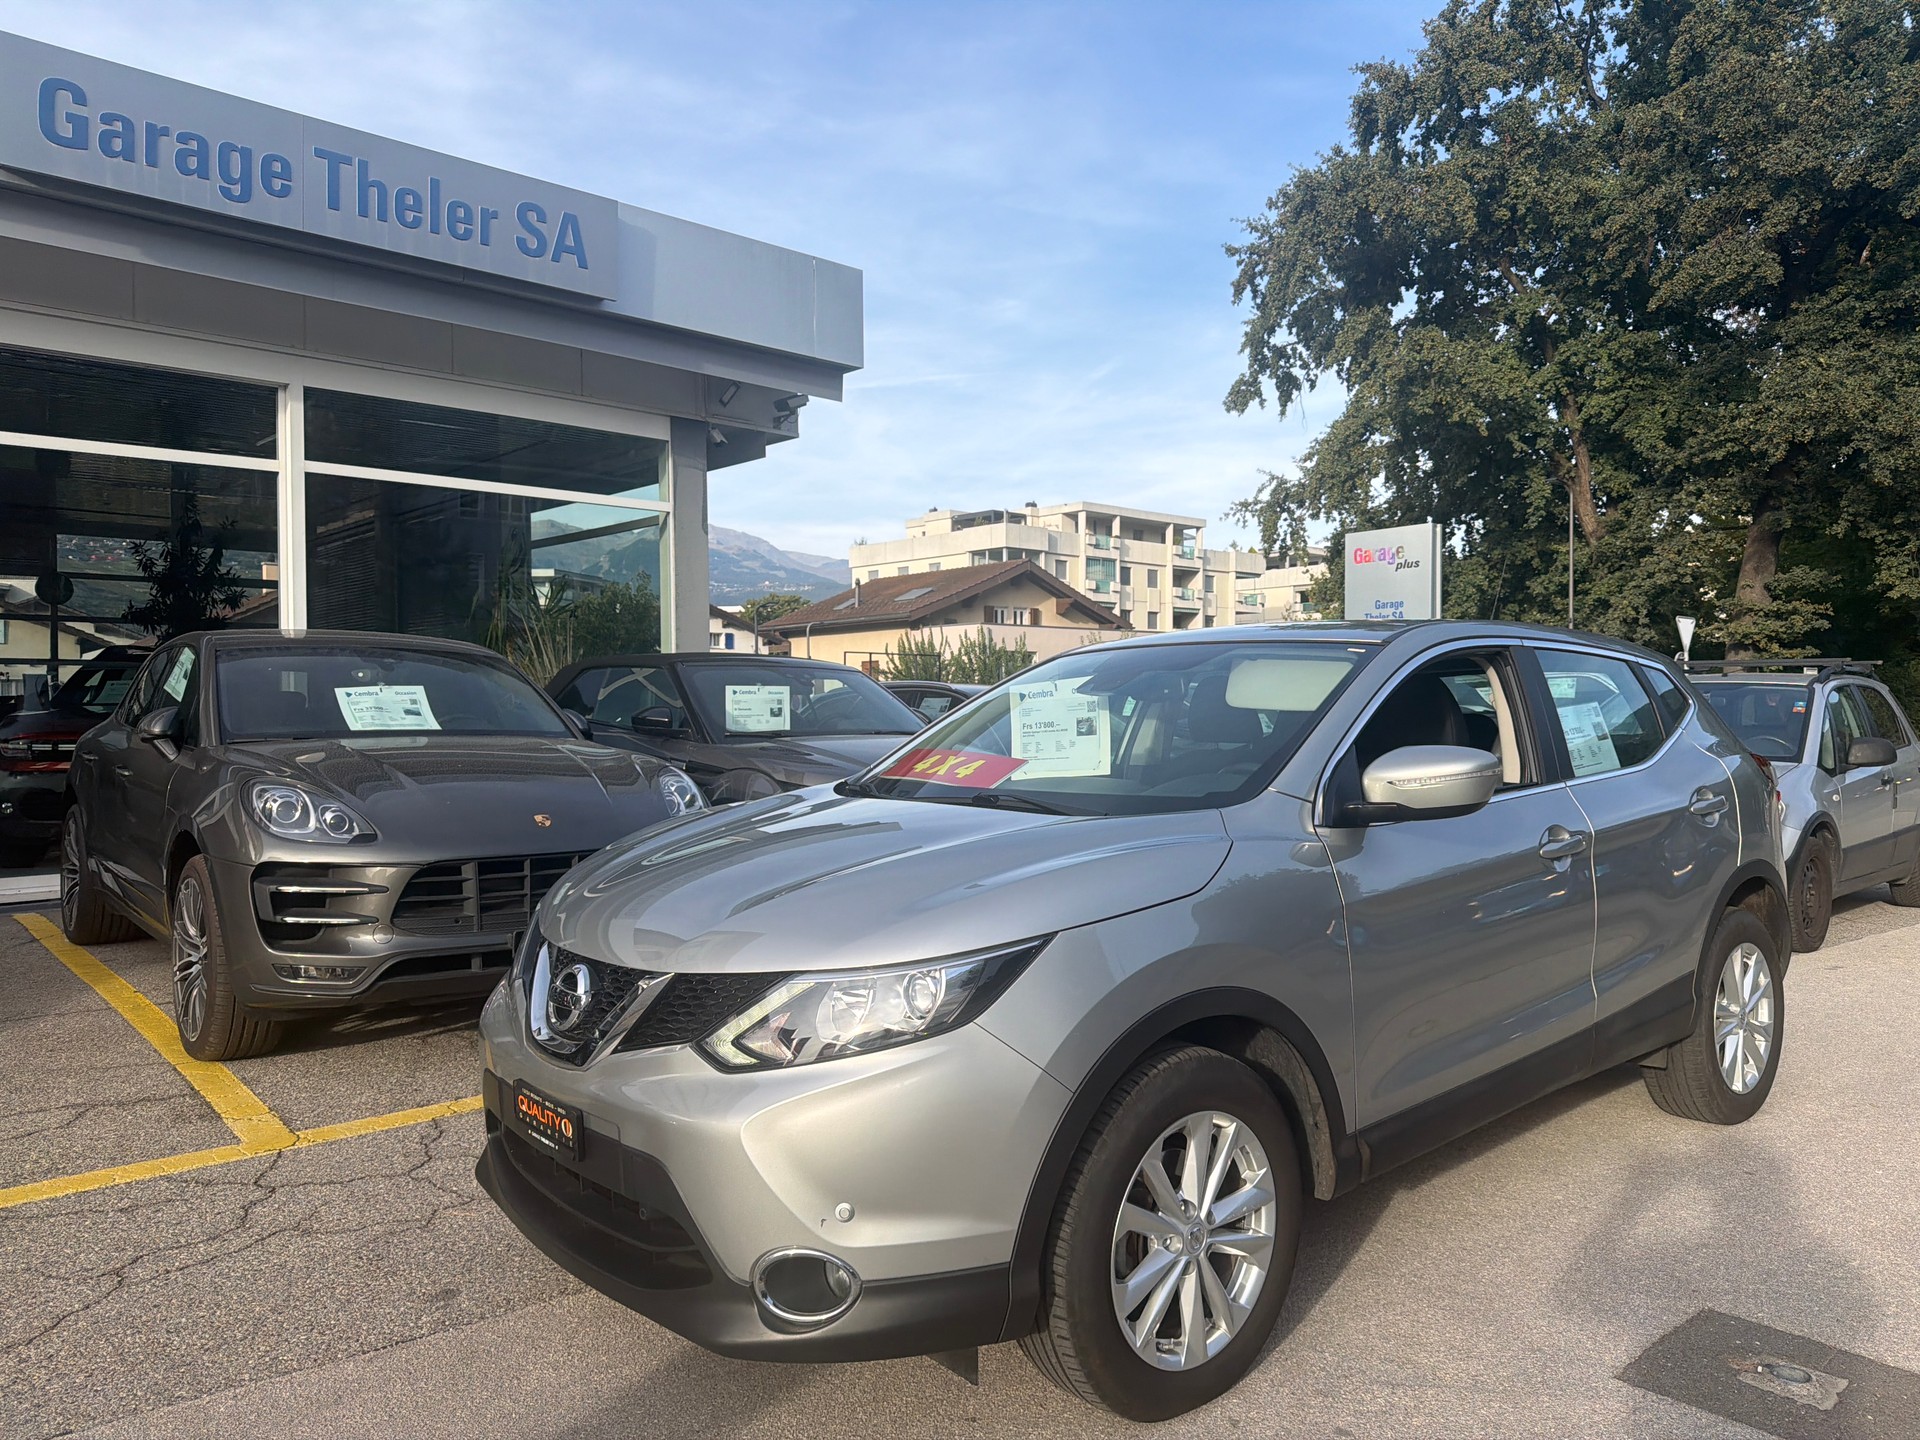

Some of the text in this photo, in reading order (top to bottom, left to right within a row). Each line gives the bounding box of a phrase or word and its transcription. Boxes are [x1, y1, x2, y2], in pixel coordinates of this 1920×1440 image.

[38, 76, 588, 270] Garage Theler SA
[1354, 546, 1405, 565] Garage
[1395, 559, 1420, 572] plus
[1375, 600, 1404, 610] Garage
[1028, 689, 1054, 699] Cembra
